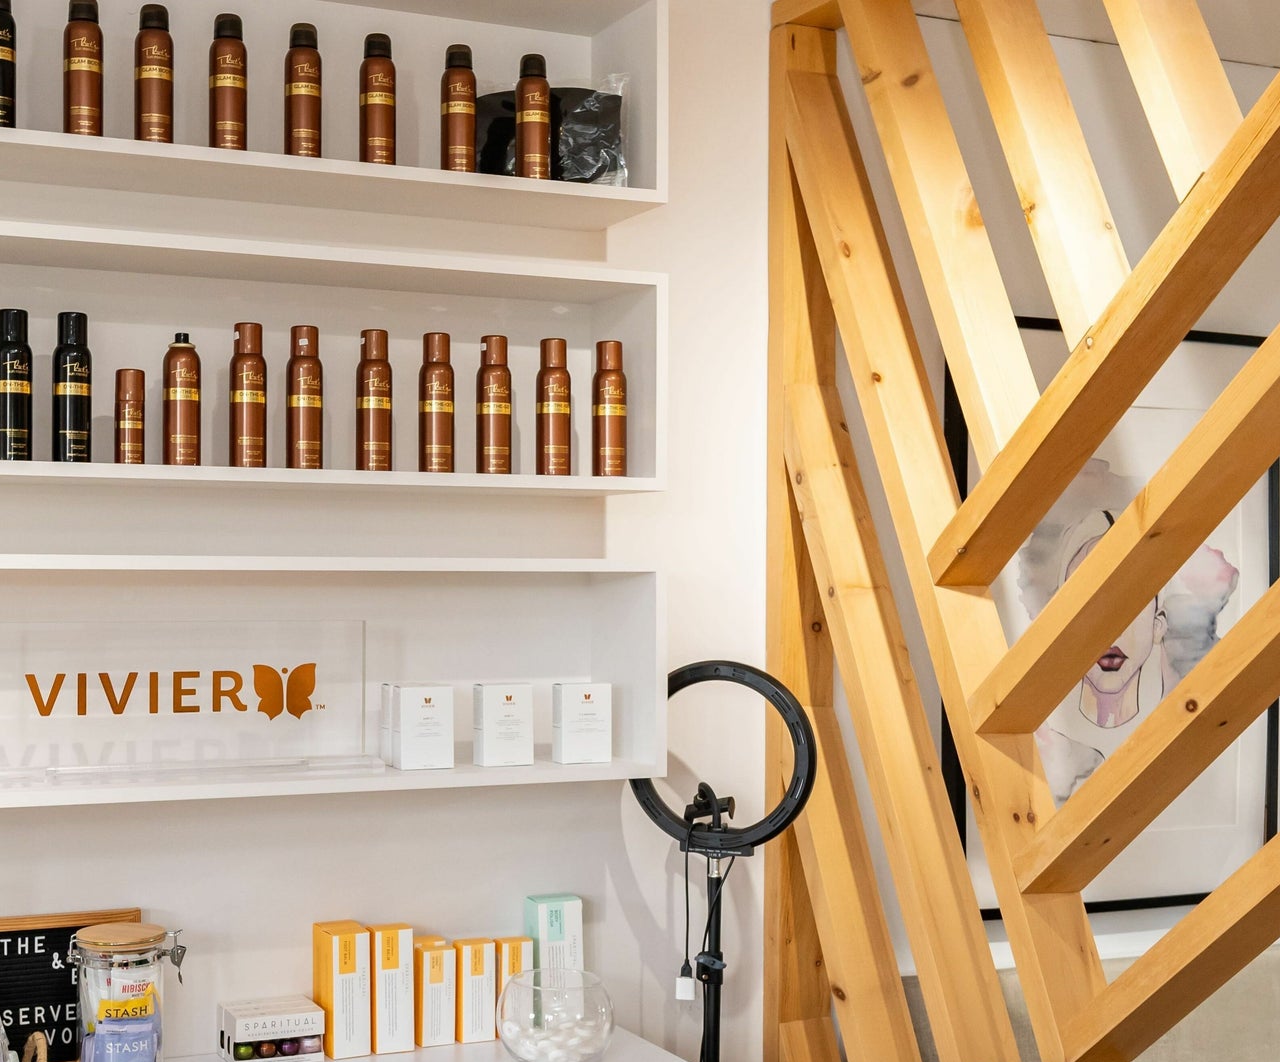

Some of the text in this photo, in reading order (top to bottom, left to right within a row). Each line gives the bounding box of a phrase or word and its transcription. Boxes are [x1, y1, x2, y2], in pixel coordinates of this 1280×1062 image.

[24, 670, 248, 717] VIVIER
[0, 935, 46, 956] THE
[51, 952, 65, 970] &
[2, 1003, 77, 1027] SERVE
[104, 1005, 148, 1019] STASH
[244, 1017, 317, 1031] SPARITUAL
[44, 1027, 79, 1046] VO
[105, 1040, 149, 1054] STASH
